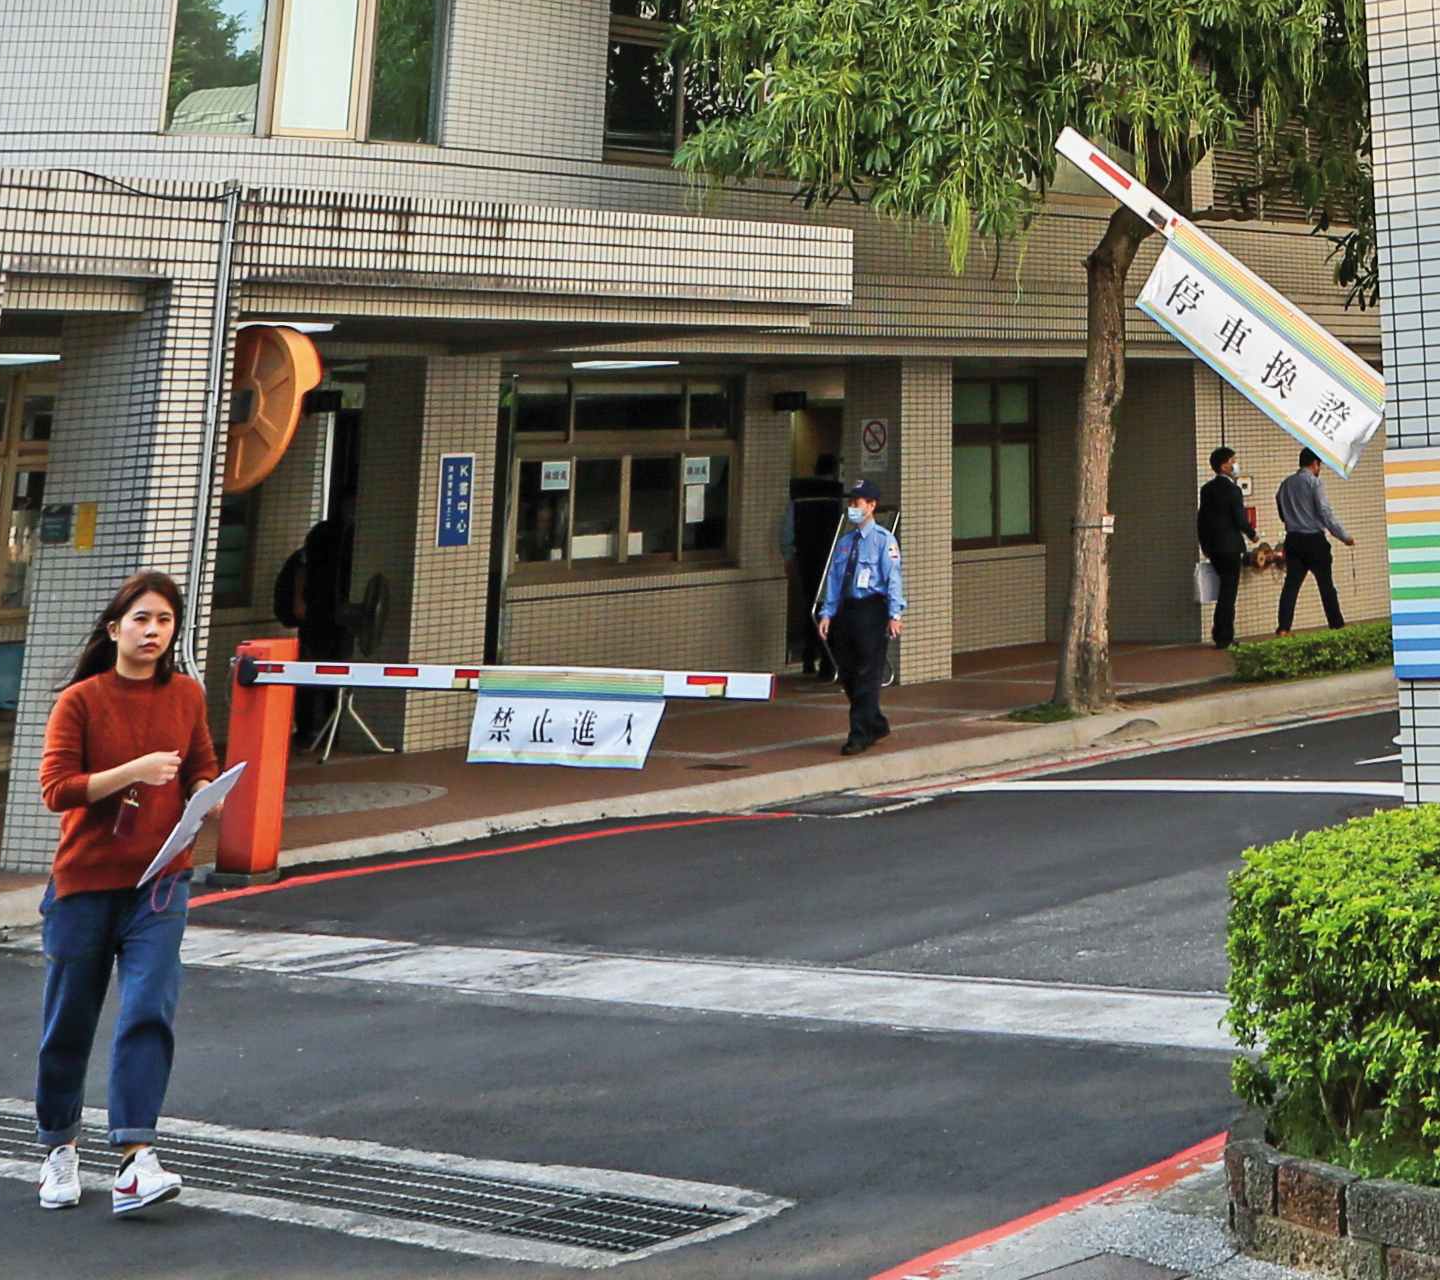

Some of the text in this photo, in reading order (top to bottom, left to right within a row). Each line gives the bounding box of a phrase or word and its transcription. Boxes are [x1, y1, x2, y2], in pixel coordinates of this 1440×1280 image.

[1165, 274, 1352, 441] 停車換證
[488, 706, 635, 746] 禁止進入
